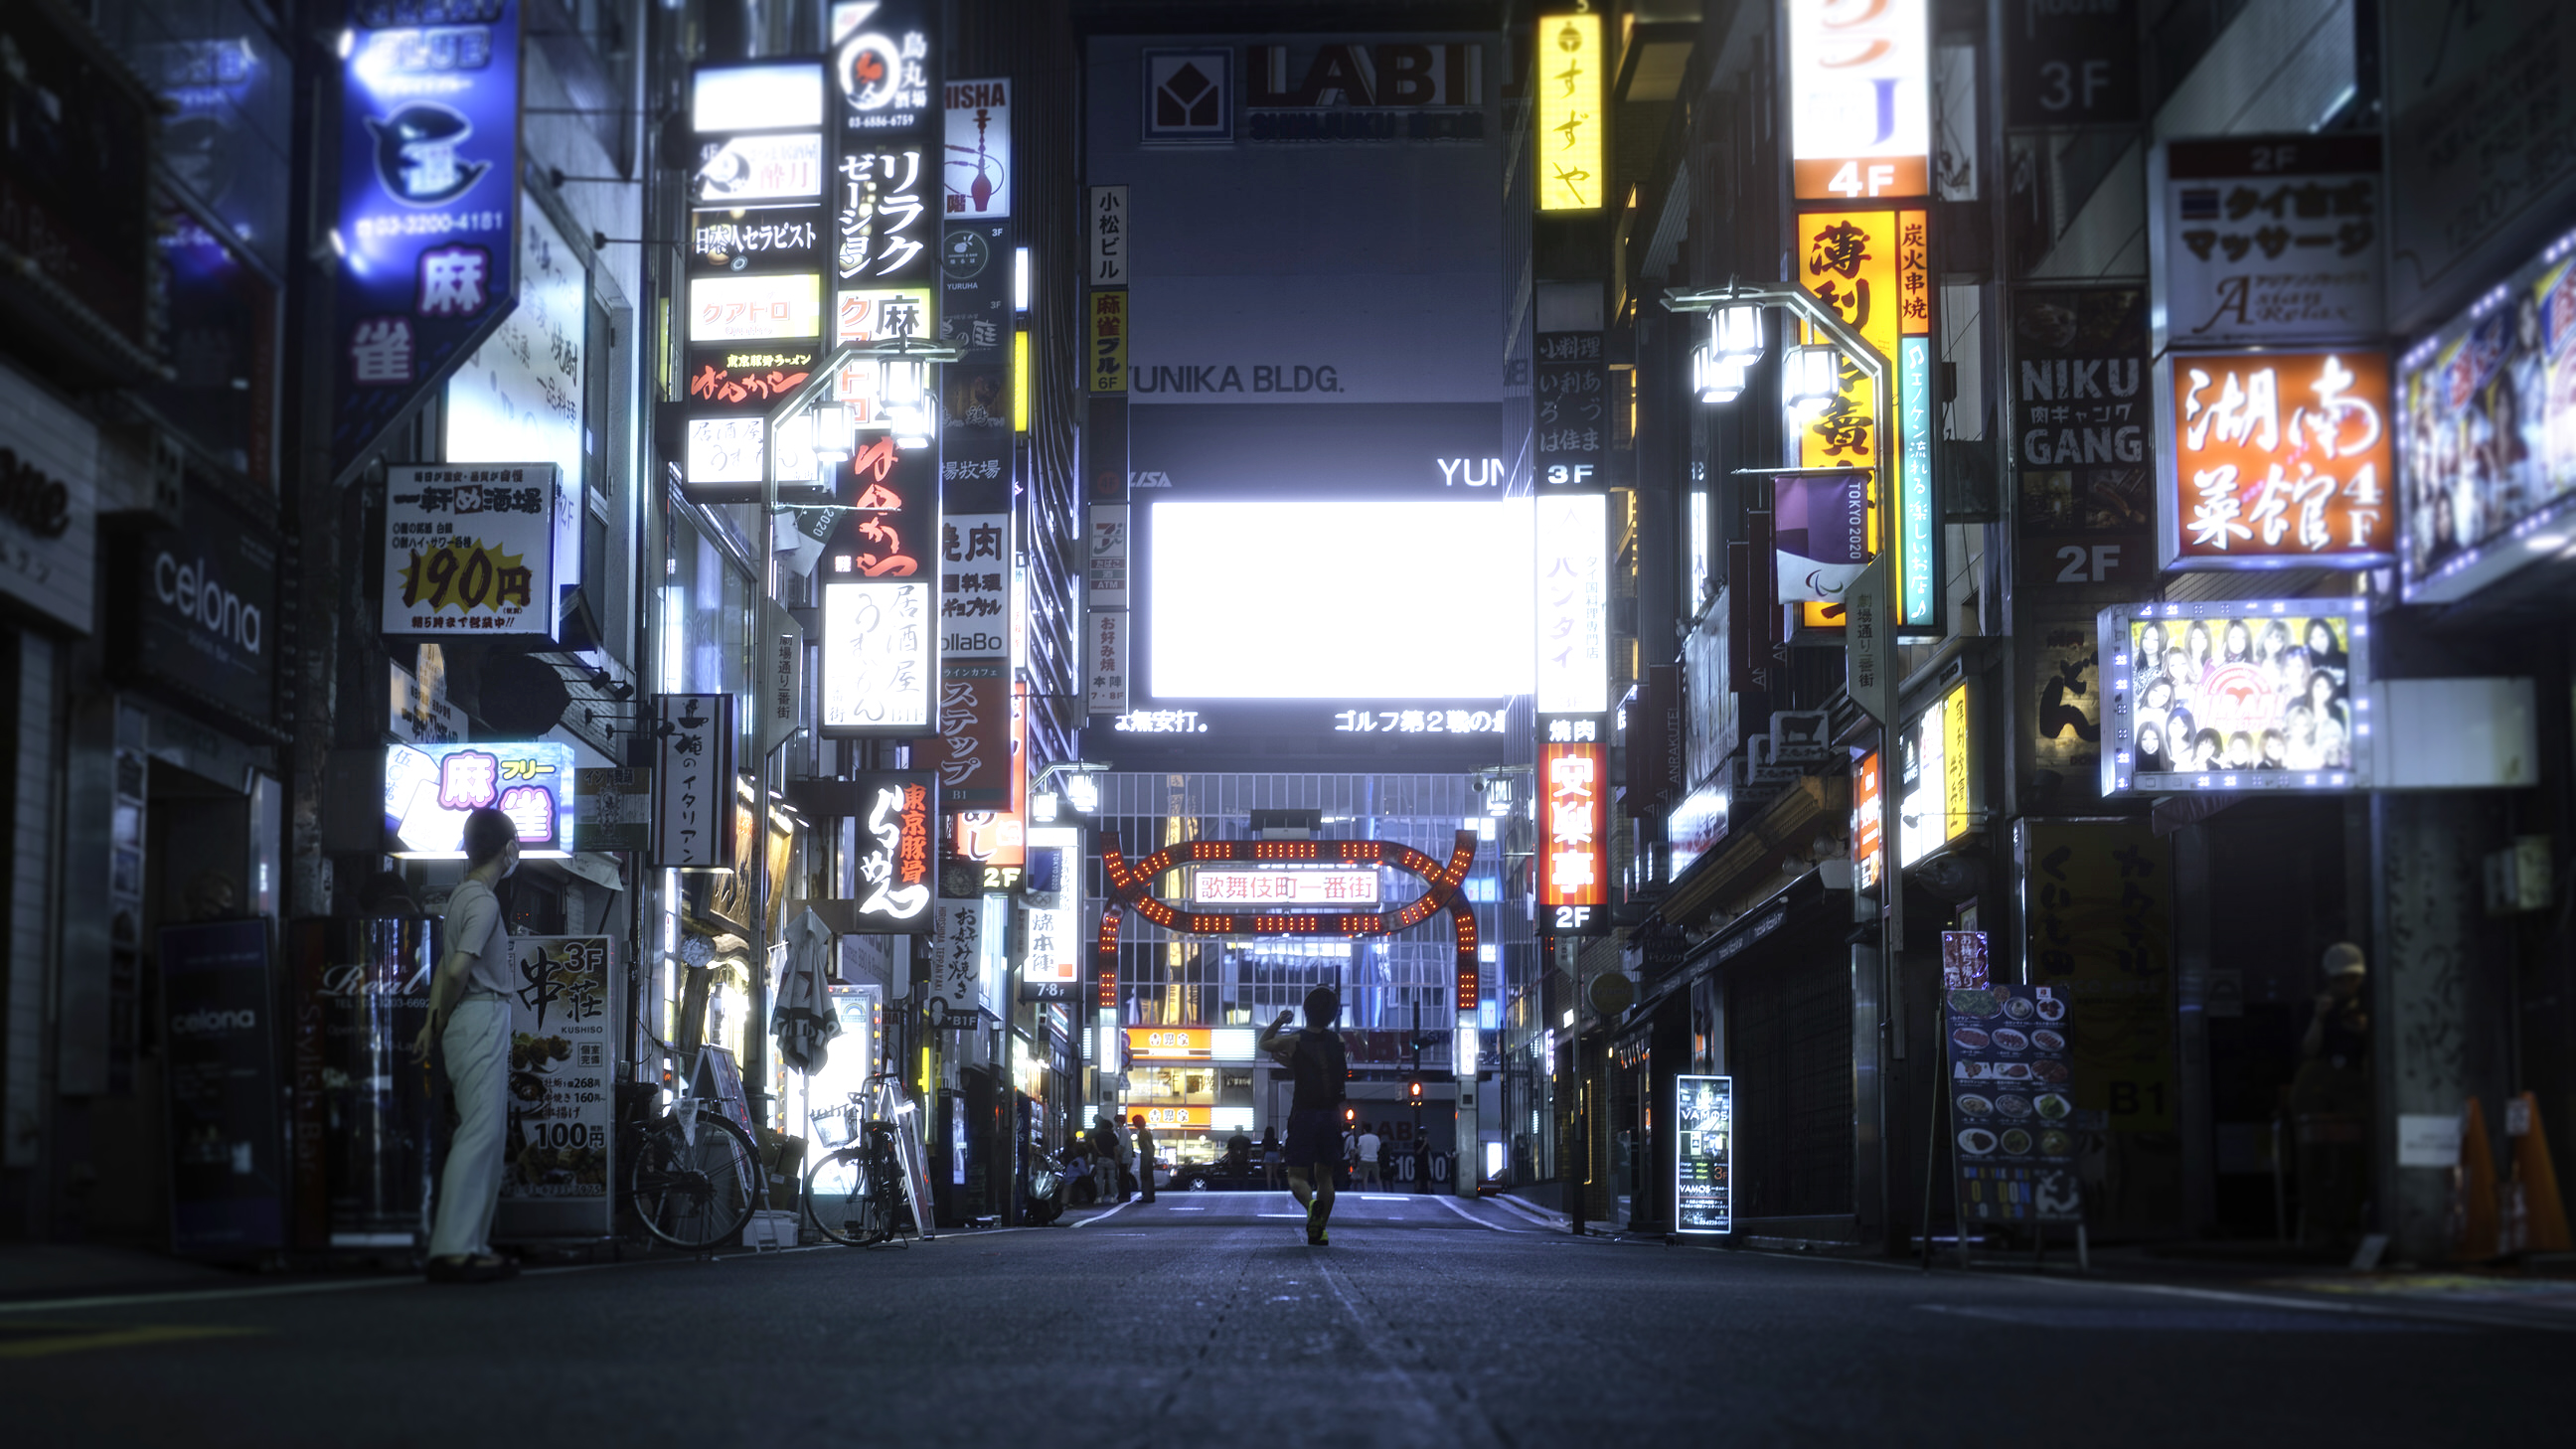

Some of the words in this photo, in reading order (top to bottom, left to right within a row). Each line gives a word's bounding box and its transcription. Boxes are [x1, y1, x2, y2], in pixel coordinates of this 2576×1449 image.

[1246, 44, 1482, 106] LABI
[2039, 60, 2111, 109] 3F
[1552, 58, 1590, 205] すずや
[2250, 145, 2299, 172] 2F
[1828, 160, 1895, 198] 4F
[695, 222, 817, 254] 日本人セラピスト
[992, 228, 1004, 238] 3F
[1099, 191, 1120, 279] 小松ビル
[2182, 221, 2373, 261] マッサージ
[947, 282, 979, 291] YURUHA
[1902, 223, 1928, 320] 炭火串焼
[1098, 377, 1118, 390] 6F
[1252, 365, 1346, 394] BLDG.
[2020, 358, 2141, 402] NIKU
[2030, 402, 2134, 424] 肉ギャング
[2185, 355, 2382, 459] 湖南
[2024, 425, 2142, 465] GANG
[1547, 464, 1594, 484] 3F
[1849, 481, 1861, 526] TOKYO
[812, 507, 835, 538] 2020
[1849, 528, 1861, 560] 2020
[402, 547, 533, 608] 190円
[2055, 545, 2122, 583] 2F
[1097, 580, 1119, 589] ATM
[154, 551, 261, 655] celona
[1099, 616, 1116, 672] お好み焼
[940, 681, 982, 786] ステップ
[1548, 719, 1597, 742] 焼肉
[501, 758, 557, 780] フリー
[952, 790, 967, 800] B1
[900, 782, 927, 885] 東京豚骨
[983, 867, 1022, 887] 2F
[1201, 876, 1371, 898] 歌舞伎町一番街
[1554, 905, 1591, 929] 2F
[564, 942, 603, 974] 3F
[947, 906, 979, 1000] お好み焼き
[170, 1008, 256, 1035] celona
[562, 1026, 603, 1035] KUSHISO
[952, 1016, 978, 1027] B1F
[2109, 1080, 2166, 1117] B1
[1682, 1110, 1728, 1121] VAMOS
[534, 1122, 605, 1149] 100円
[1680, 1184, 1711, 1194] VAMOS
